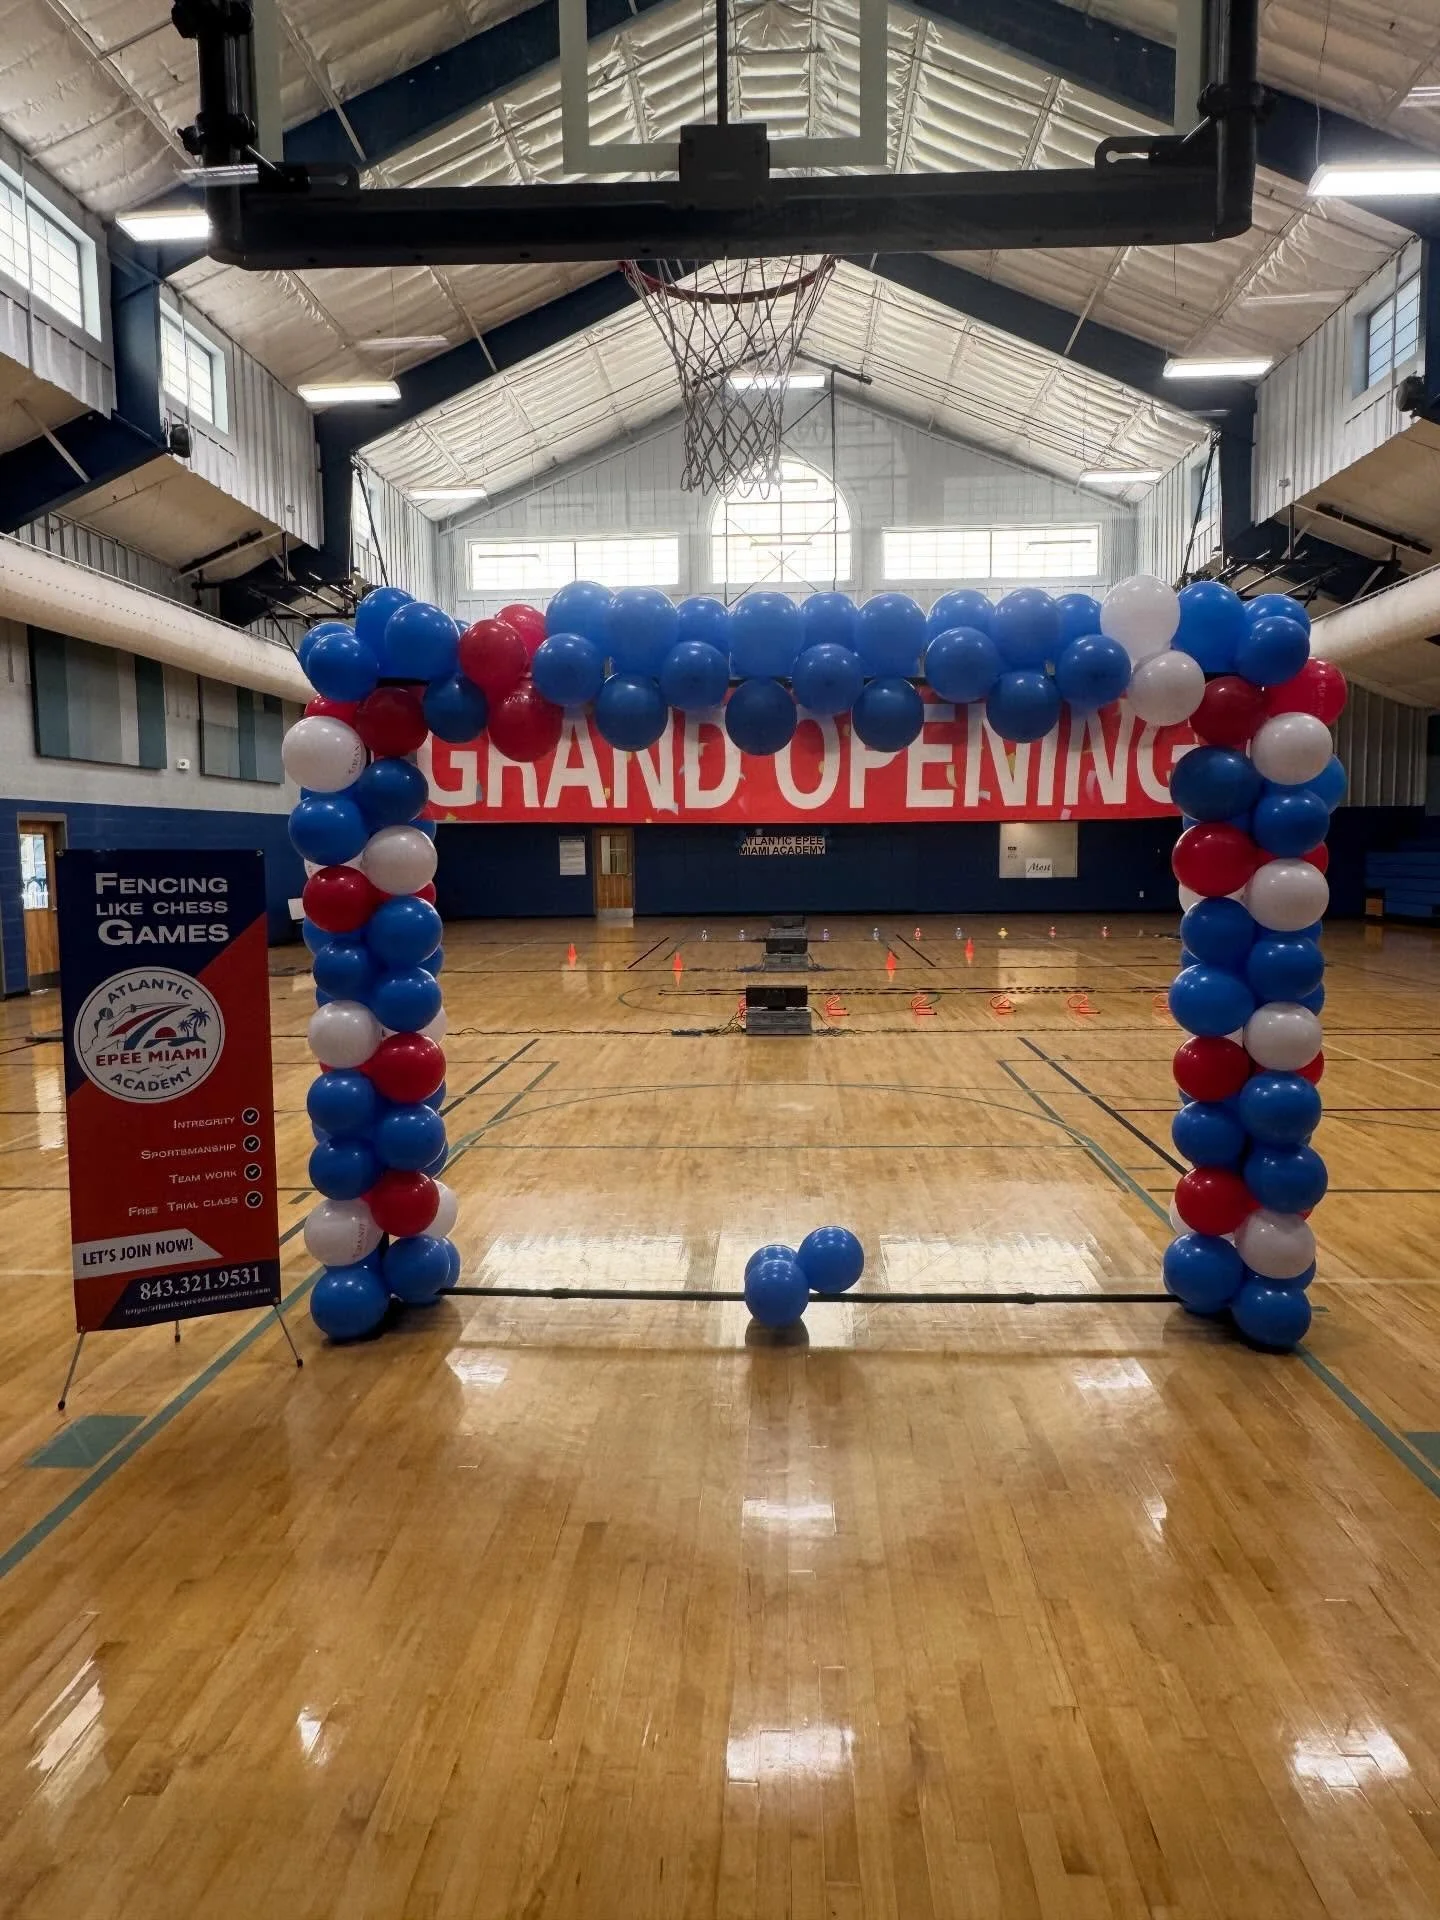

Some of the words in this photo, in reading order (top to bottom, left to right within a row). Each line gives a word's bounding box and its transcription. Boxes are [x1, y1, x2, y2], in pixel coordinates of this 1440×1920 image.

[739, 846, 770, 855] MIAMI
[772, 846, 825, 855] ACADEMY
[742, 836, 792, 846] ATLANTIC
[795, 837, 824, 846] EPEE
[96, 902, 144, 916] LIKE
[152, 901, 229, 915] CHESS
[107, 978, 193, 1005] ATLANTIC
[96, 1052, 142, 1067] EPEE
[148, 1047, 208, 1062] MIAMI
[110, 1066, 193, 1093] ACADEMY
[120, 1244, 152, 1261] JOIN
[156, 1238, 194, 1255] NOW!
[140, 1266, 260, 1300] 843.321.9531
